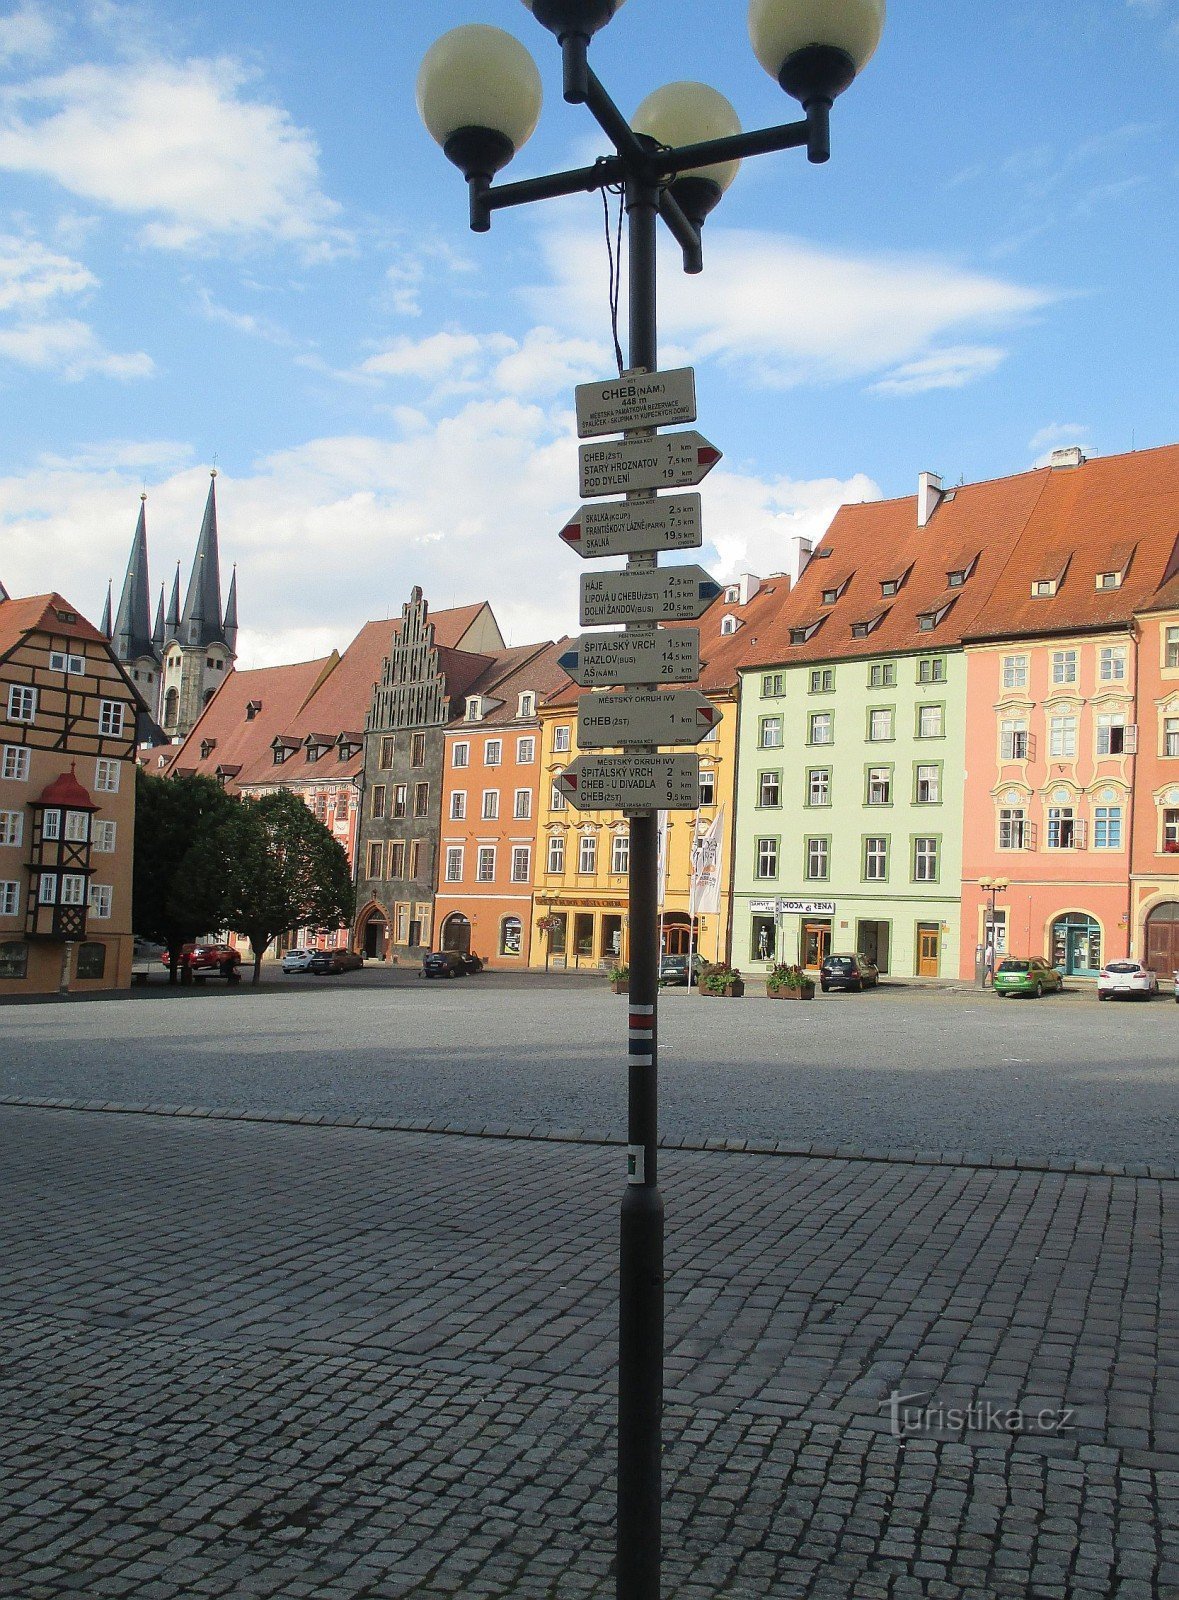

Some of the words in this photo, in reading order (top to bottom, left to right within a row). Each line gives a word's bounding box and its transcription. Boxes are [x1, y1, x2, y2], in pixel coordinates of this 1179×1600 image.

[648, 400, 678, 410] REZERVACE
[667, 443, 672, 452] 1
[585, 462, 609, 474] STARÝ
[611, 458, 658, 471] HROZNATOV
[668, 456, 680, 465] 7,5
[585, 478, 600, 487] POD
[602, 472, 630, 486] DYLENÍ
[662, 469, 674, 478] 19
[586, 523, 625, 536] FRANTIŠKOVY
[586, 536, 609, 548] SKALNÁ
[585, 580, 603, 590] HÁJE
[669, 577, 681, 586] 2,5
[585, 592, 609, 603] LIPOVÁ
[612, 593, 616, 601] U
[663, 590, 681, 598] 11,5
[585, 604, 606, 615] DOLNÍ
[663, 603, 681, 611] 20,5
[584, 640, 630, 652] ŠPITÁLSKÝ
[632, 640, 656, 649] VRCH
[668, 639, 680, 648] 1,5
[662, 652, 679, 661] 14,5
[661, 665, 673, 673] 26
[599, 695, 633, 704] MĚSTSKÝ
[670, 714, 675, 723] 1
[582, 766, 627, 777] ŠPITÁLSKÝ
[629, 768, 653, 777] VRCH
[667, 768, 673, 776] 2
[582, 780, 604, 788] CHEB
[612, 780, 617, 788] U
[620, 780, 656, 788] DIVADLA
[667, 780, 672, 788] 6
[667, 792, 678, 801] 9,5
